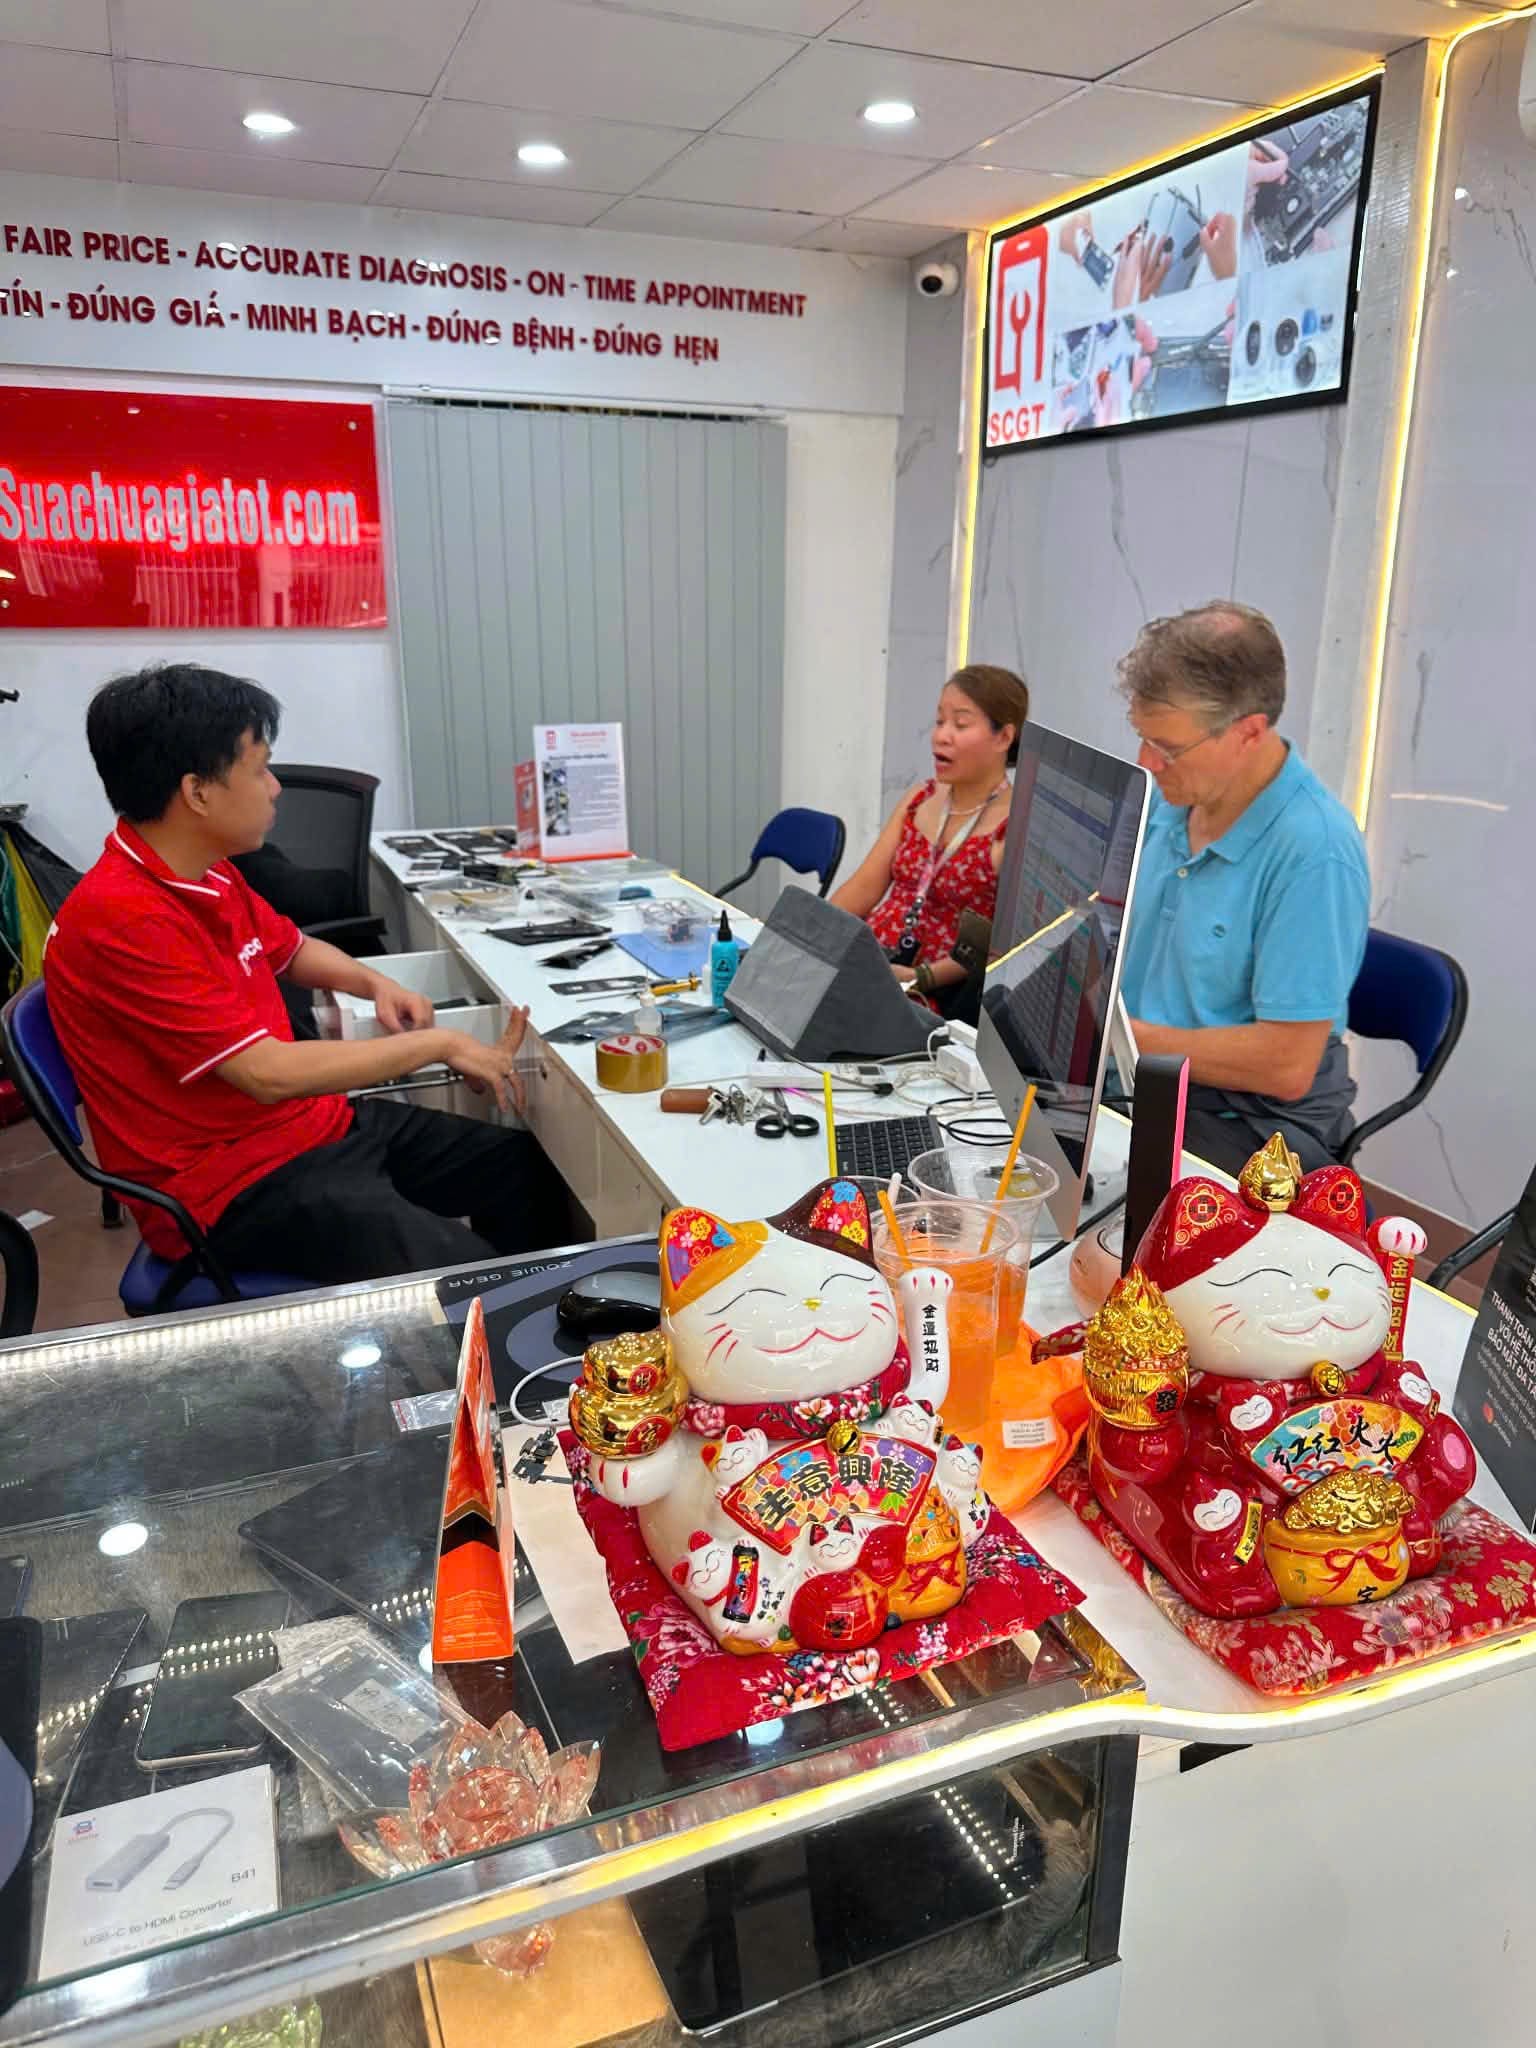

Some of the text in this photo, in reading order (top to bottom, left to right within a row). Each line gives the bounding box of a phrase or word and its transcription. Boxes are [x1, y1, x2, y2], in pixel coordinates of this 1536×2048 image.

[3, 224, 73, 258] FAIR
[83, 231, 171, 265] PRICE
[195, 241, 351, 279] ACCURATE
[360, 255, 507, 293] DIAGNOSIS
[527, 270, 565, 297] ON
[584, 274, 636, 303] TIME
[645, 280, 807, 317] APPOINTMENT
[67, 284, 156, 323] ĐÚNG
[169, 290, 225, 328] GIÁ
[247, 303, 318, 334] MINH
[328, 309, 406, 342] BẠCH
[427, 310, 501, 344] ĐÚNG
[512, 317, 575, 355] BỆNH
[594, 322, 663, 358] ĐÚNG
[674, 335, 720, 366] HẸN
[990, 403, 1046, 445] SCGT
[0, 467, 361, 553] Suachuagiatot.com
[448, 1260, 576, 1288] ZOWIE GEAR
[1491, 1289, 1516, 1326] THANH
[144, 1914, 176, 1931] HDMI
